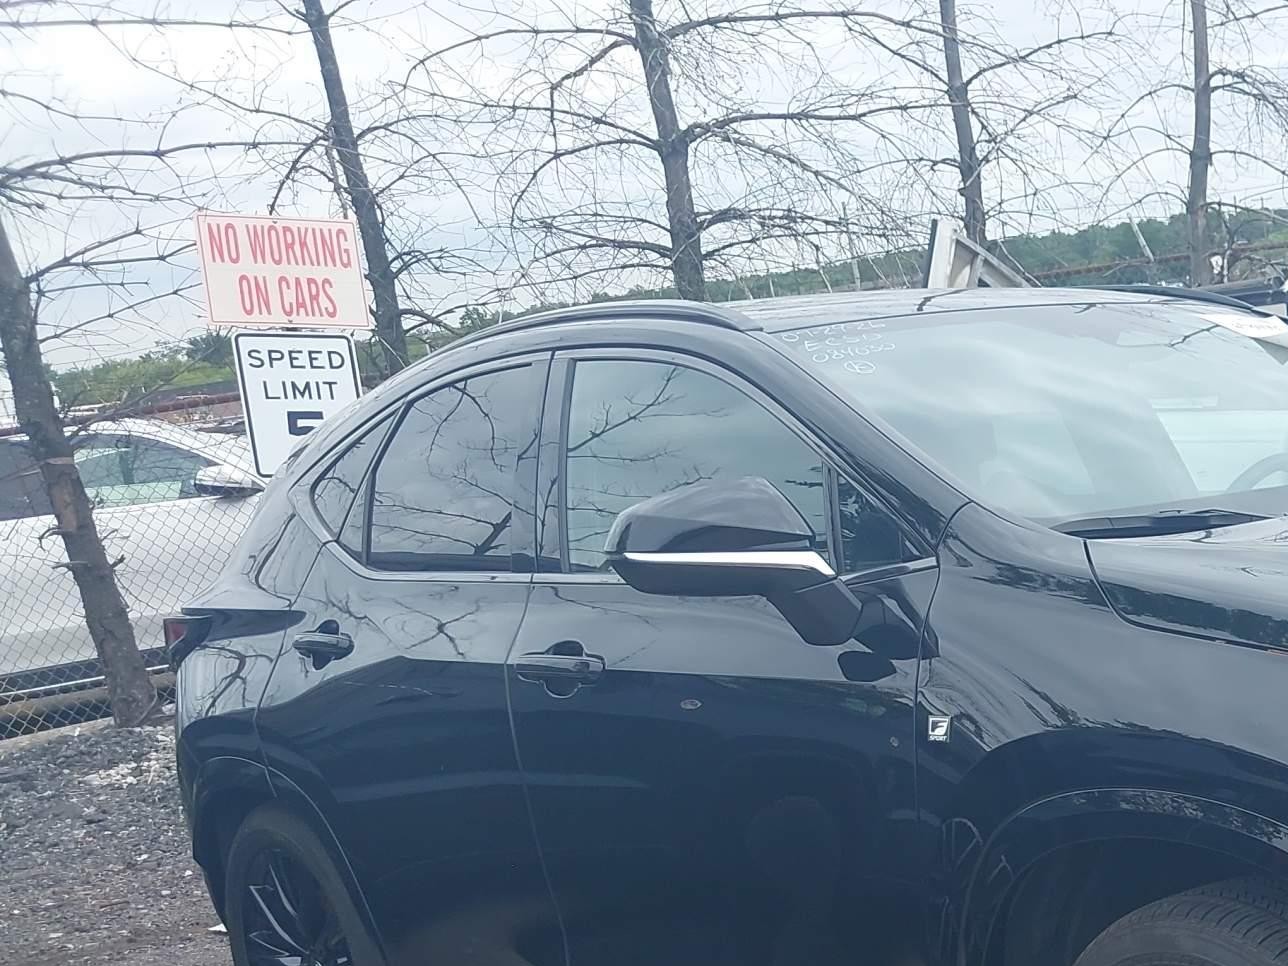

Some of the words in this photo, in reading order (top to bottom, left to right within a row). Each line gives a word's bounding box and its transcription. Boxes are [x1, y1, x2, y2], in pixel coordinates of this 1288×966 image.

[207, 222, 241, 264] NO
[245, 223, 352, 269] WORKING
[238, 274, 272, 317] ON
[277, 275, 337, 318] CARS
[247, 349, 345, 370] SPEED
[262, 380, 338, 400] LIMIT
